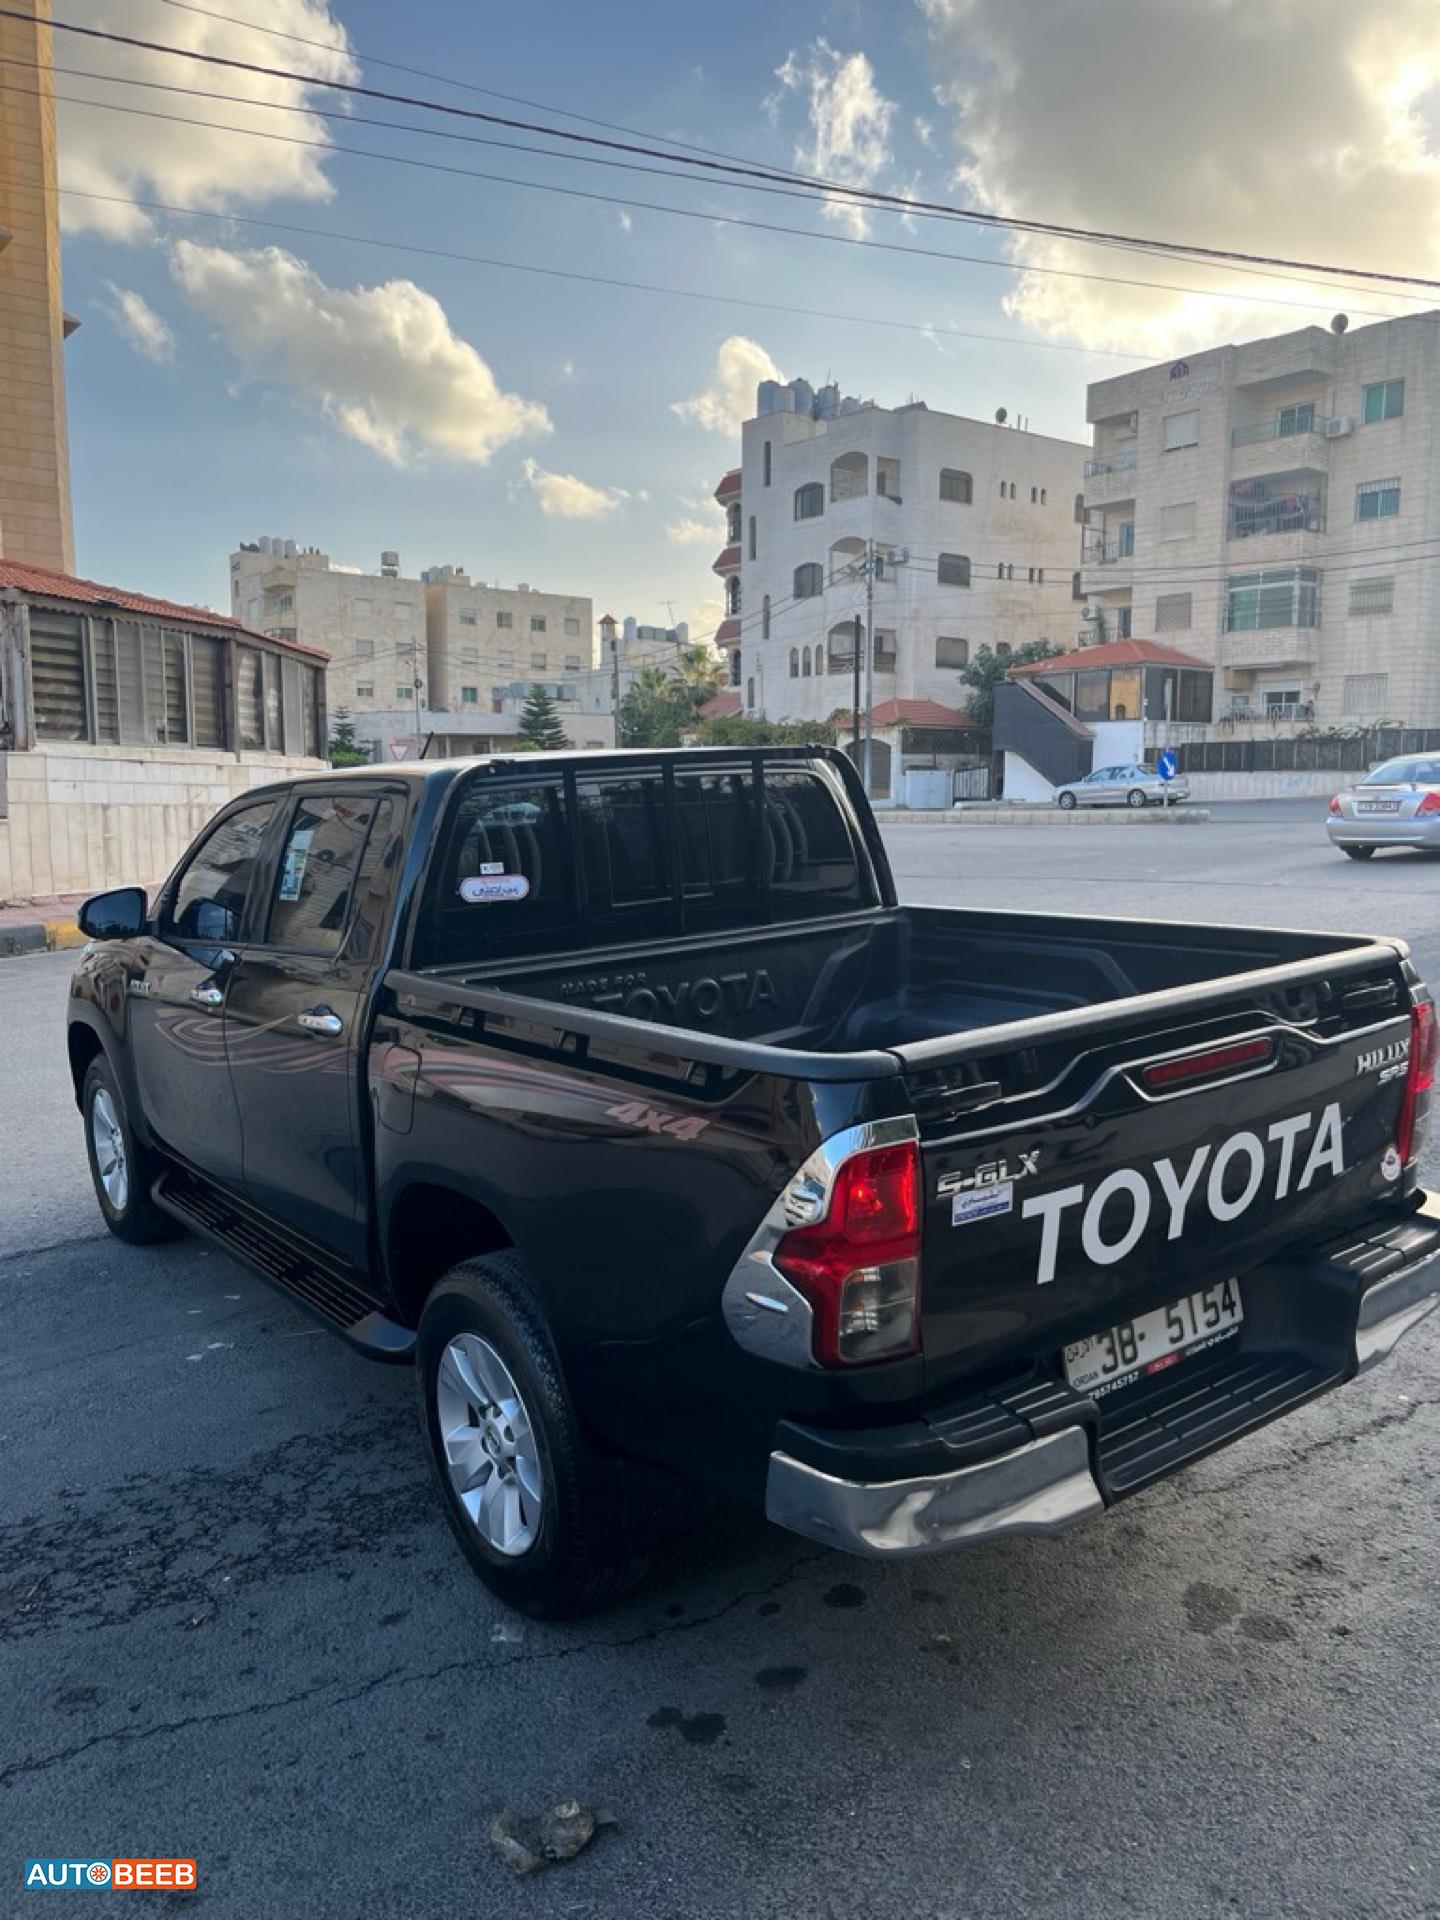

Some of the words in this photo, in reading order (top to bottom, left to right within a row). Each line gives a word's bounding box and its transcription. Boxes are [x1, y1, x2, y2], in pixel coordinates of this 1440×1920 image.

[592, 968, 780, 1019] TOYOTA
[1357, 1038, 1409, 1076] HILUX
[936, 1149, 1040, 1200] S-GLX
[1021, 1102, 1346, 1285] TOYOTA
[1166, 1279, 1237, 1344] 5154
